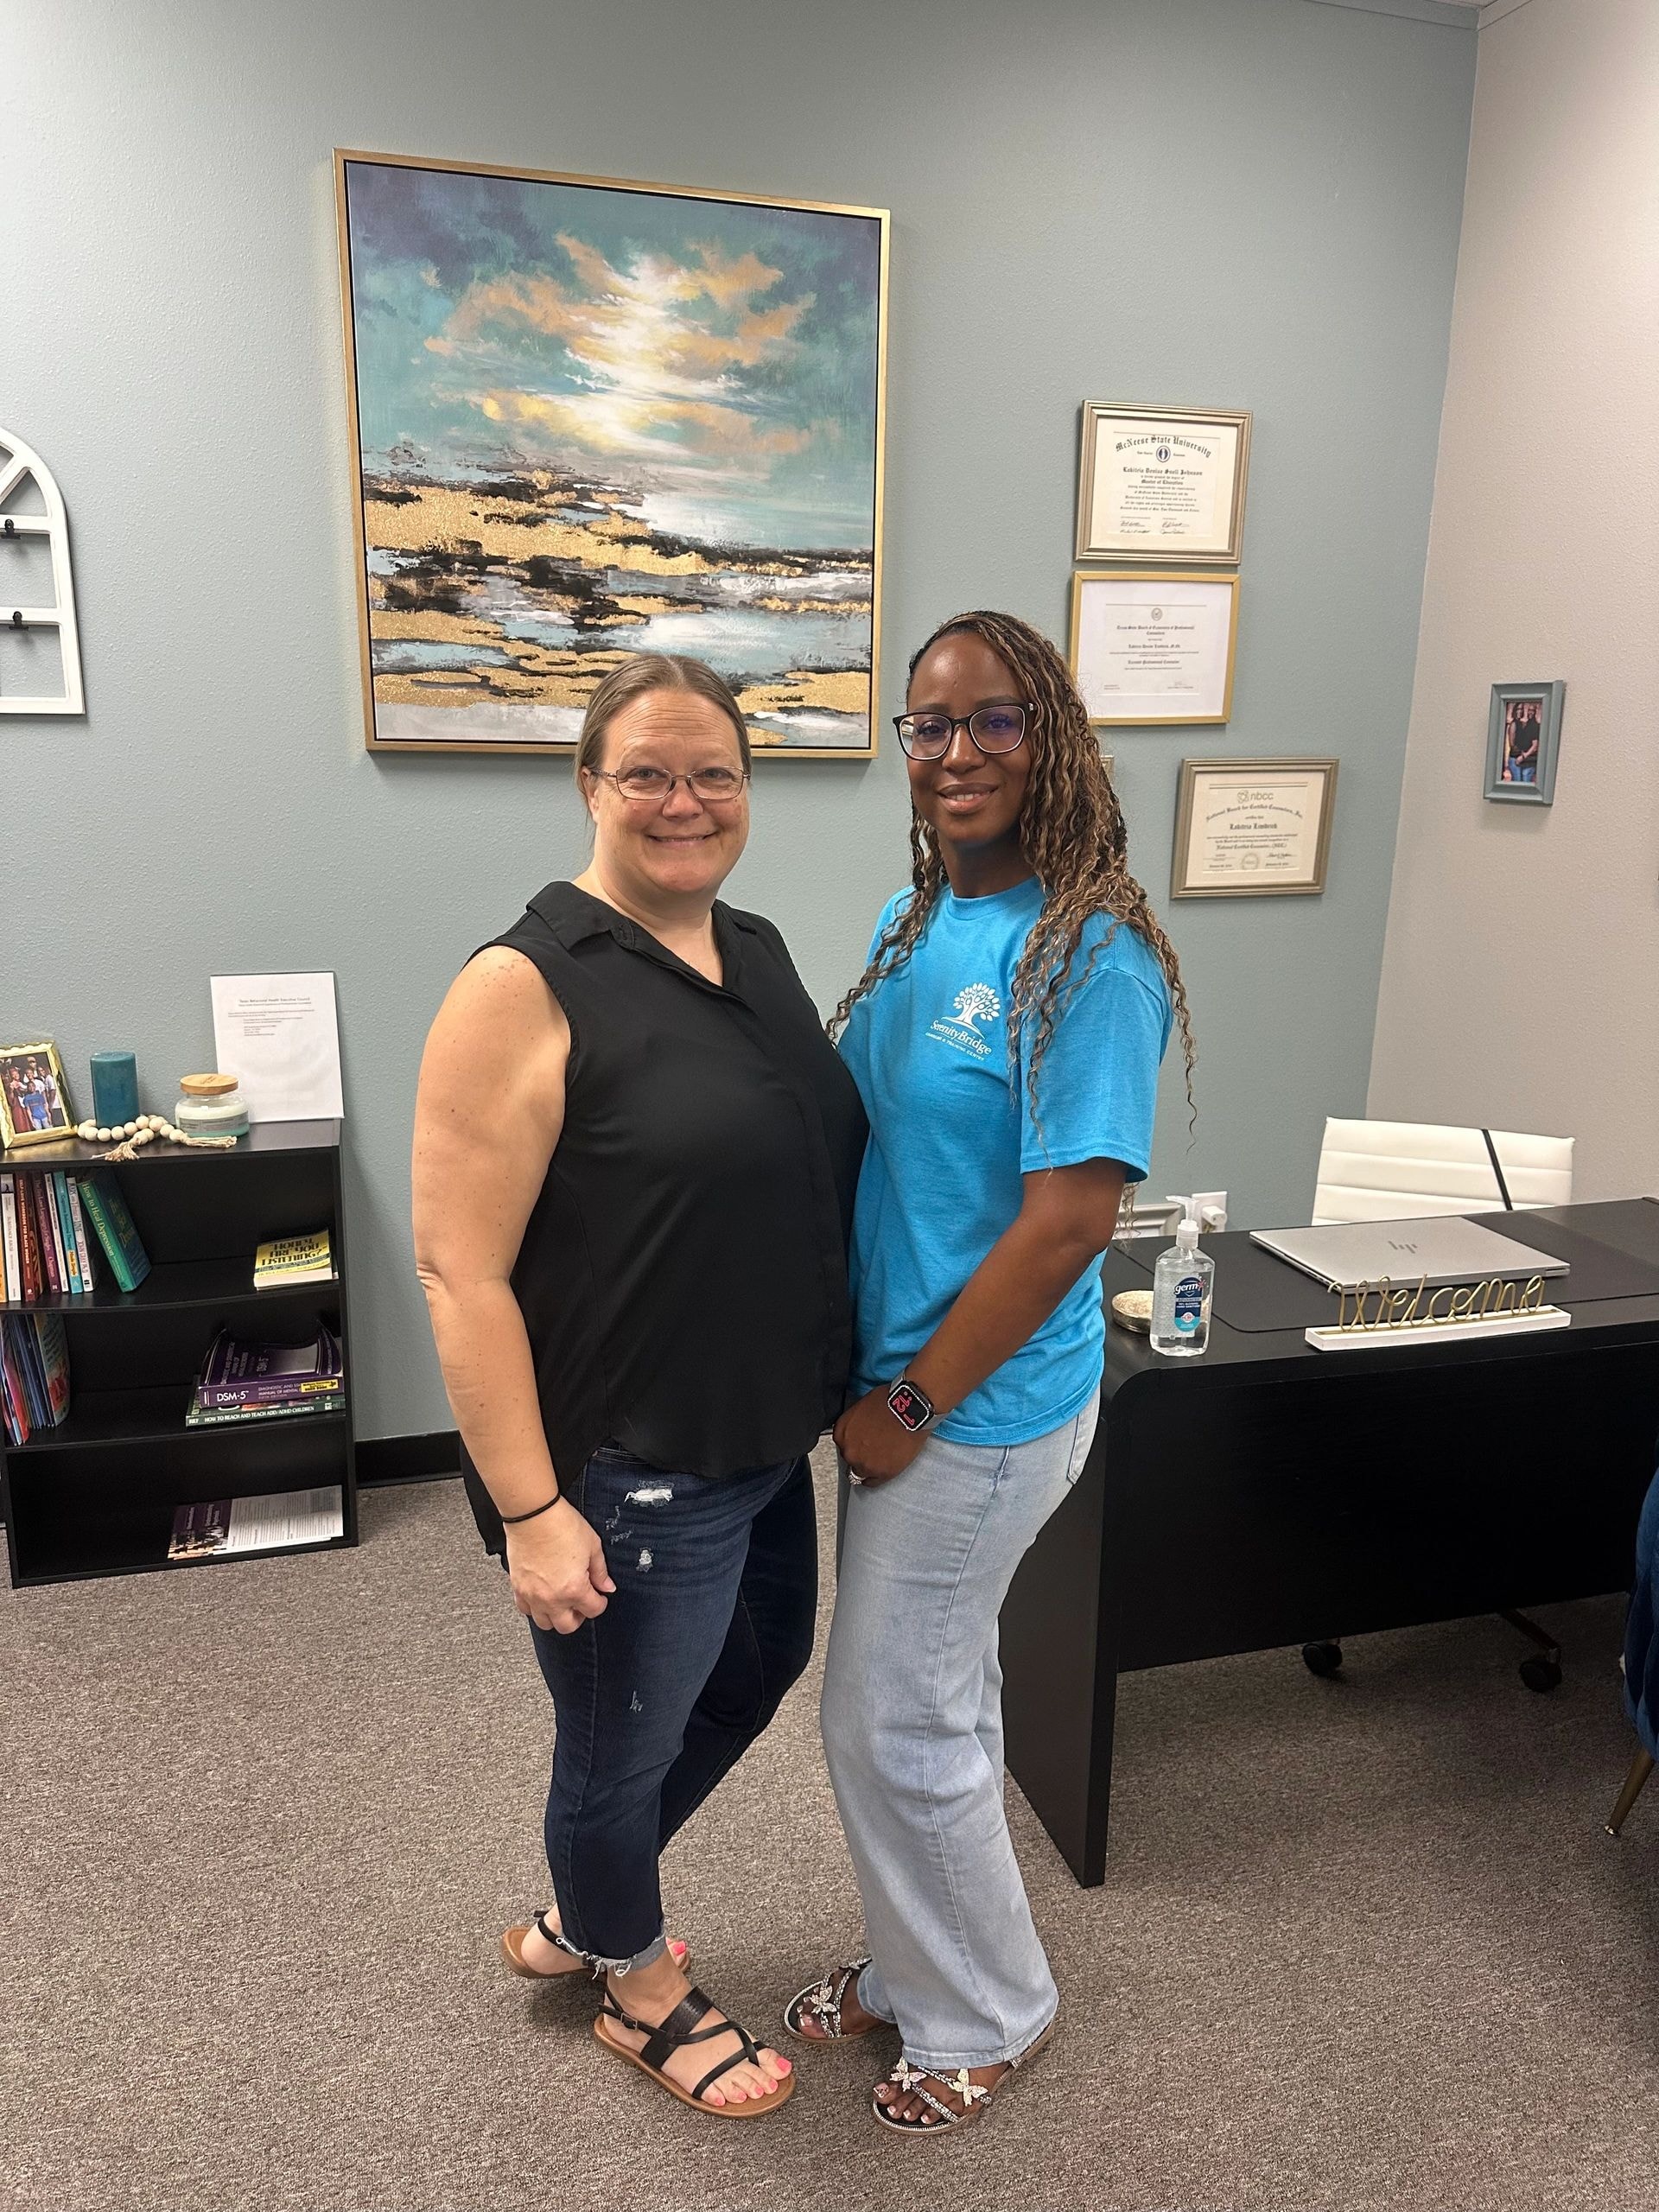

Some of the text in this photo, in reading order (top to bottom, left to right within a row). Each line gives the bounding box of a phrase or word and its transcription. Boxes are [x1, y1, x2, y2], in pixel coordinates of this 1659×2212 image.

[1116, 435, 1211, 459] McNeese State University
[1250, 791, 1274, 800] nbcc
[931, 1020, 992, 1054] SerenityBridge
[81, 1181, 117, 1257] How to Heal Depression
[1388, 1240, 1417, 1254] hp
[1327, 1273, 1546, 1332] Welcome
